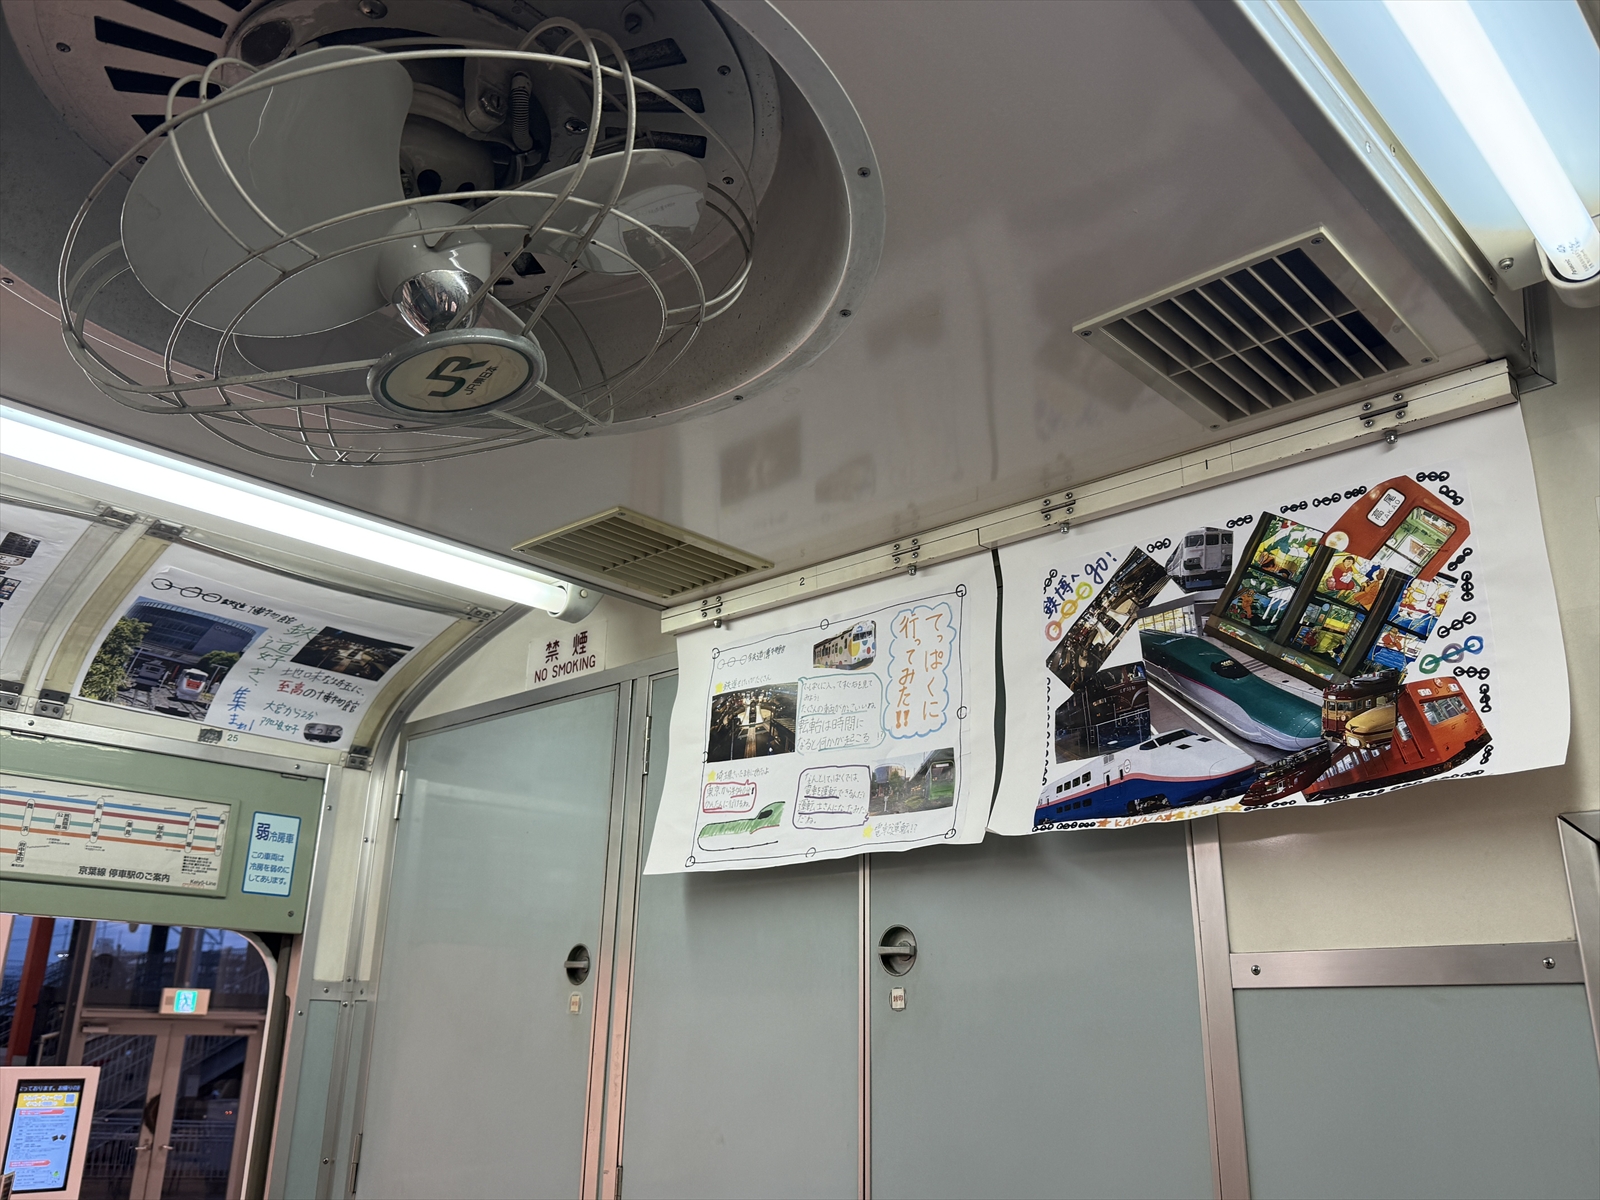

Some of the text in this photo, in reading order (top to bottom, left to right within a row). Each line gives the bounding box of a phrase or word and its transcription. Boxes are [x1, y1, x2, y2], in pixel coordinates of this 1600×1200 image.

[1371, 493, 1397, 520] 高尾
[1381, 499, 1401, 522] TAKAO
[799, 576, 805, 587] 2
[545, 630, 588, 664] 禁煙
[534, 654, 596, 684] NO SMOKING
[922, 613, 944, 721] てっぱくに
[277, 679, 360, 713] 至高の博物館
[227, 734, 239, 742] 25
[251, 851, 285, 862] この車両は
[78, 865, 171, 883] 京葉線 停車駅のご案内
[249, 862, 290, 874] 冷房を弱めに
[248, 873, 287, 886] してあります。
